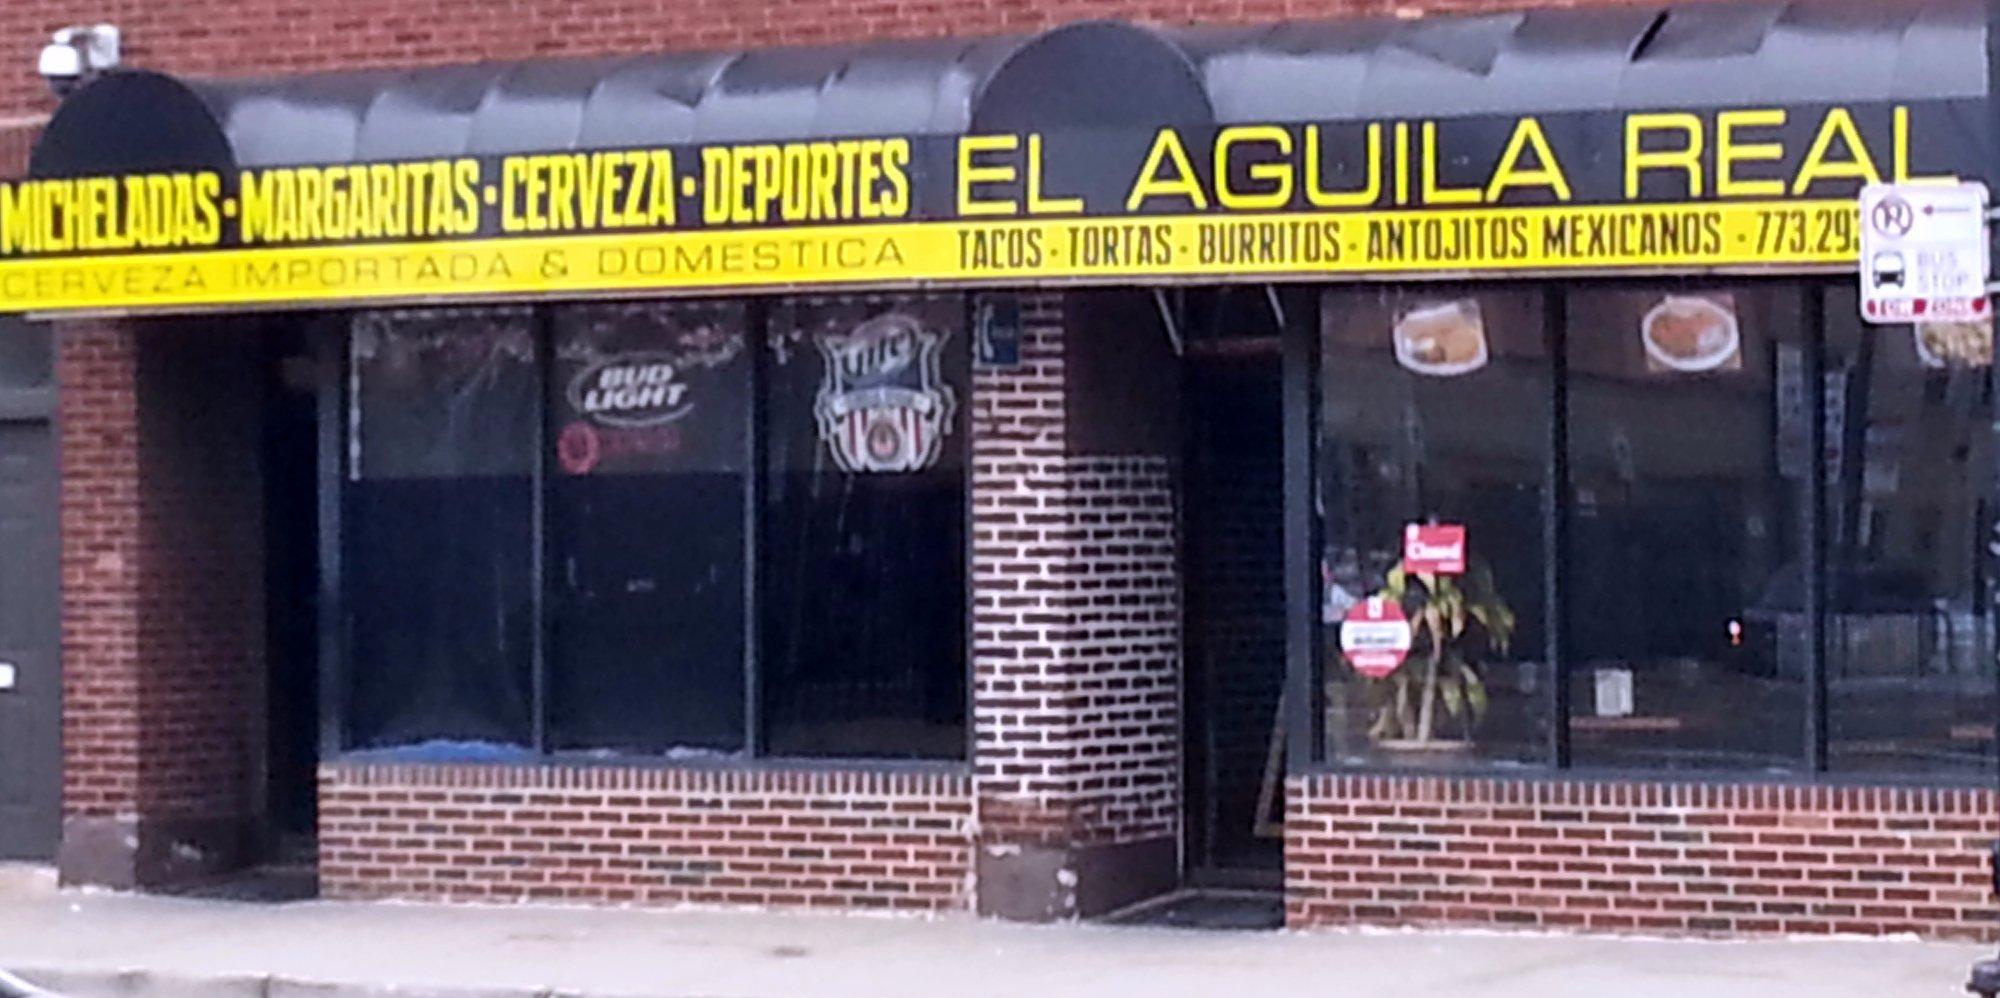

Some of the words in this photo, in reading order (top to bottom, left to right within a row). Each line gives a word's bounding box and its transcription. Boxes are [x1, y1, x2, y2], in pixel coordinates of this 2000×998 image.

[957, 132, 1084, 215] EL
[1126, 116, 1571, 211] AGUILA
[1625, 106, 1960, 198] REAL
[0, 172, 220, 254] MICHELADAS
[240, 159, 480, 243] MARGARITAS
[502, 150, 675, 232] CERVEZA
[702, 138, 909, 225] DEPORTES
[2, 263, 207, 299] CERVEZA
[232, 252, 512, 289] IMPORTADA
[540, 249, 568, 278] &
[600, 236, 906, 276] DOMESTICA
[957, 227, 1043, 270] TACOS
[1068, 223, 1172, 266] TORTAS
[1200, 219, 1341, 264] BURRITOS
[1366, 213, 1528, 260] ANTOJITOS
[1542, 210, 1722, 257] MEXICANOS
[584, 383, 689, 411] LIGHT
[600, 363, 673, 389] BUD
